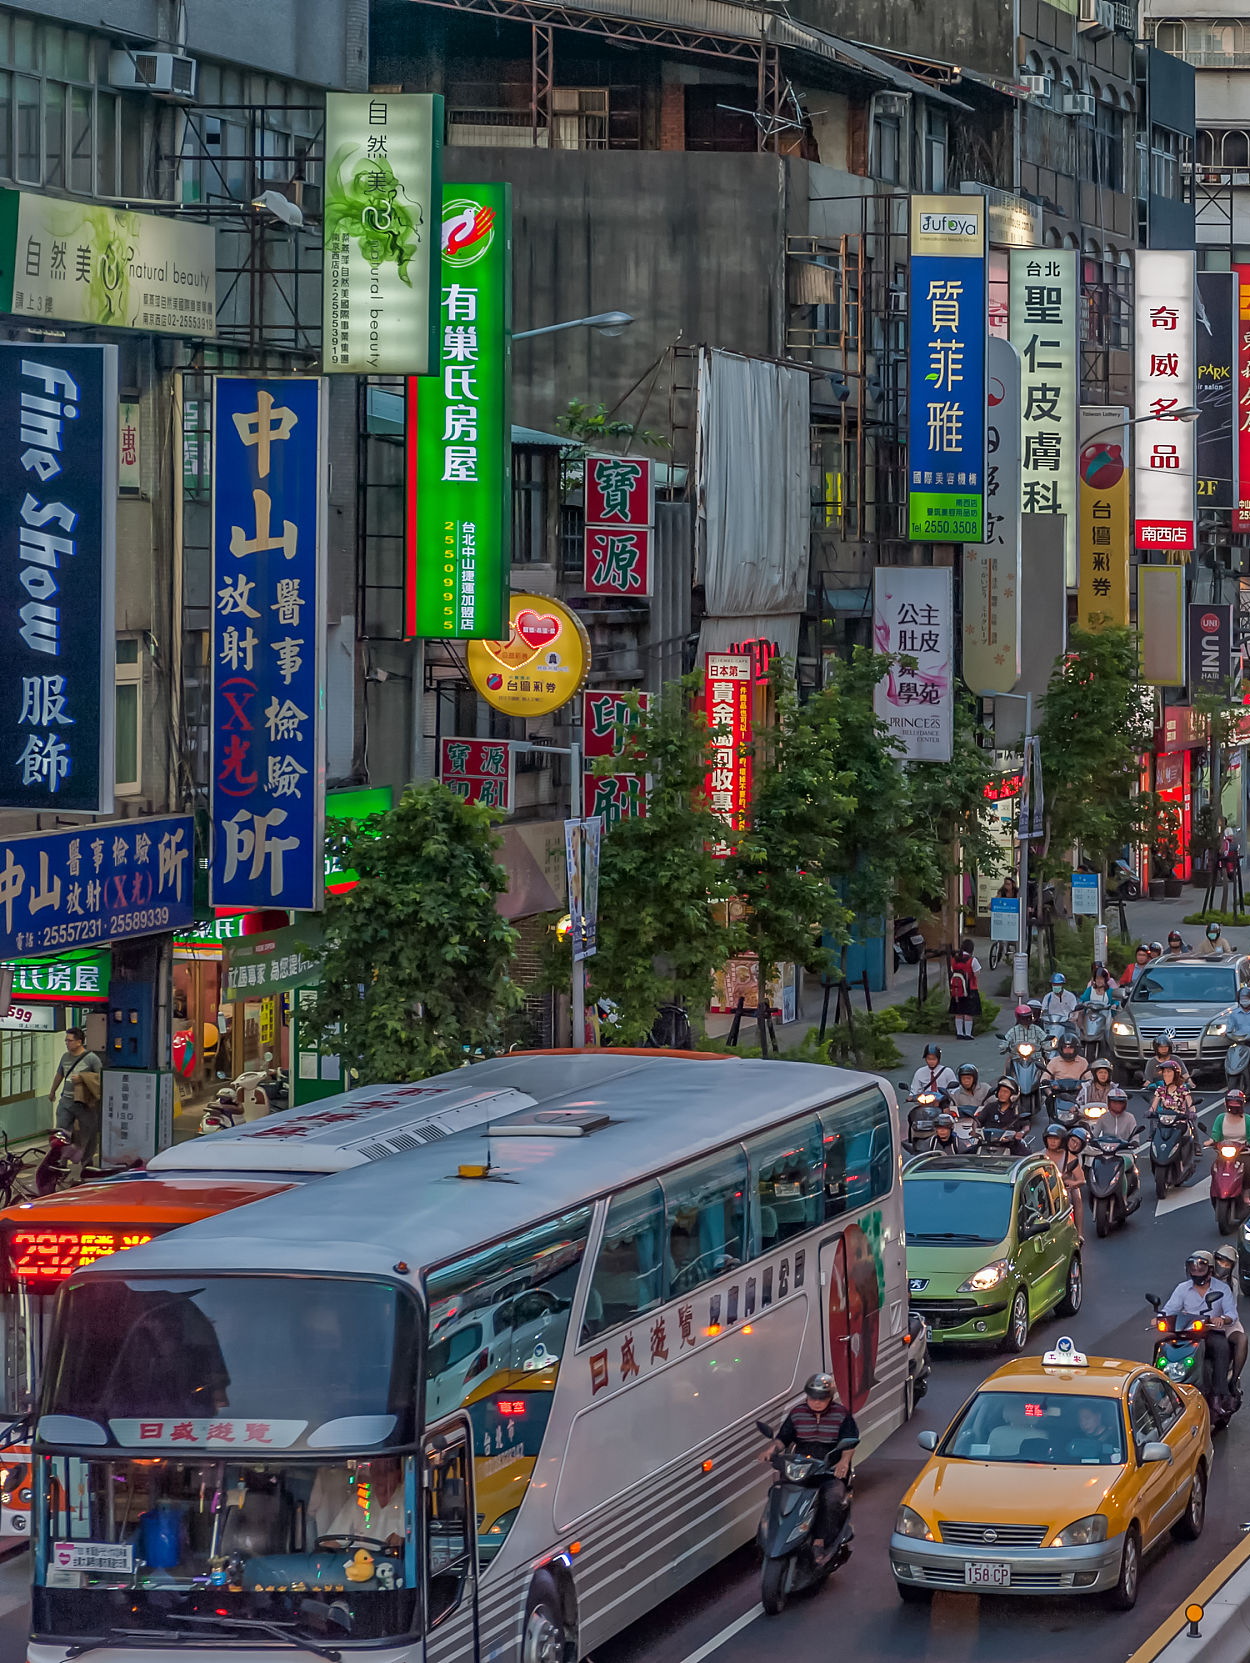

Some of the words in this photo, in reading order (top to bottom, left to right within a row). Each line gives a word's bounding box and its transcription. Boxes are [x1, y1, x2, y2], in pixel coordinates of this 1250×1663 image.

[367, 98, 388, 193] 自然美
[26, 235, 91, 284] 自然美
[129, 261, 168, 282] natural
[173, 266, 210, 294] beauty
[1026, 261, 1060, 277] 台北
[367, 308, 384, 368] beauty
[440, 284, 481, 482] 有巢氏房屋
[925, 280, 965, 453] 質菲雅
[1149, 305, 1180, 470] 奇威名品
[1023, 285, 1063, 514] 聖仁皮膚科
[230, 390, 299, 559] 中山
[913, 471, 977, 486] 國際美容機構
[1196, 480, 1218, 496] 2F
[591, 460, 642, 592] 寶源
[912, 522, 922, 533] Tel
[924, 520, 977, 535] 2550.3508
[1141, 526, 1187, 543] 南西店
[443, 521, 454, 630] 25509955
[897, 602, 941, 627] 公主
[898, 630, 941, 653] 肚皮
[709, 664, 748, 677] 日本第一
[1201, 635, 1220, 672] UNI
[1201, 672, 1220, 680] HAIR
[217, 572, 262, 797] 放射(X光)
[264, 578, 309, 799] 醫事檢驗
[897, 682, 941, 706] 學苑
[15, 674, 76, 793] 服飾
[66, 832, 152, 877] 醫事檢驗
[158, 828, 189, 903] 所
[221, 807, 300, 897] 所
[0, 848, 62, 935] 中山
[138, 1421, 273, 1445] 日盛遊覽
